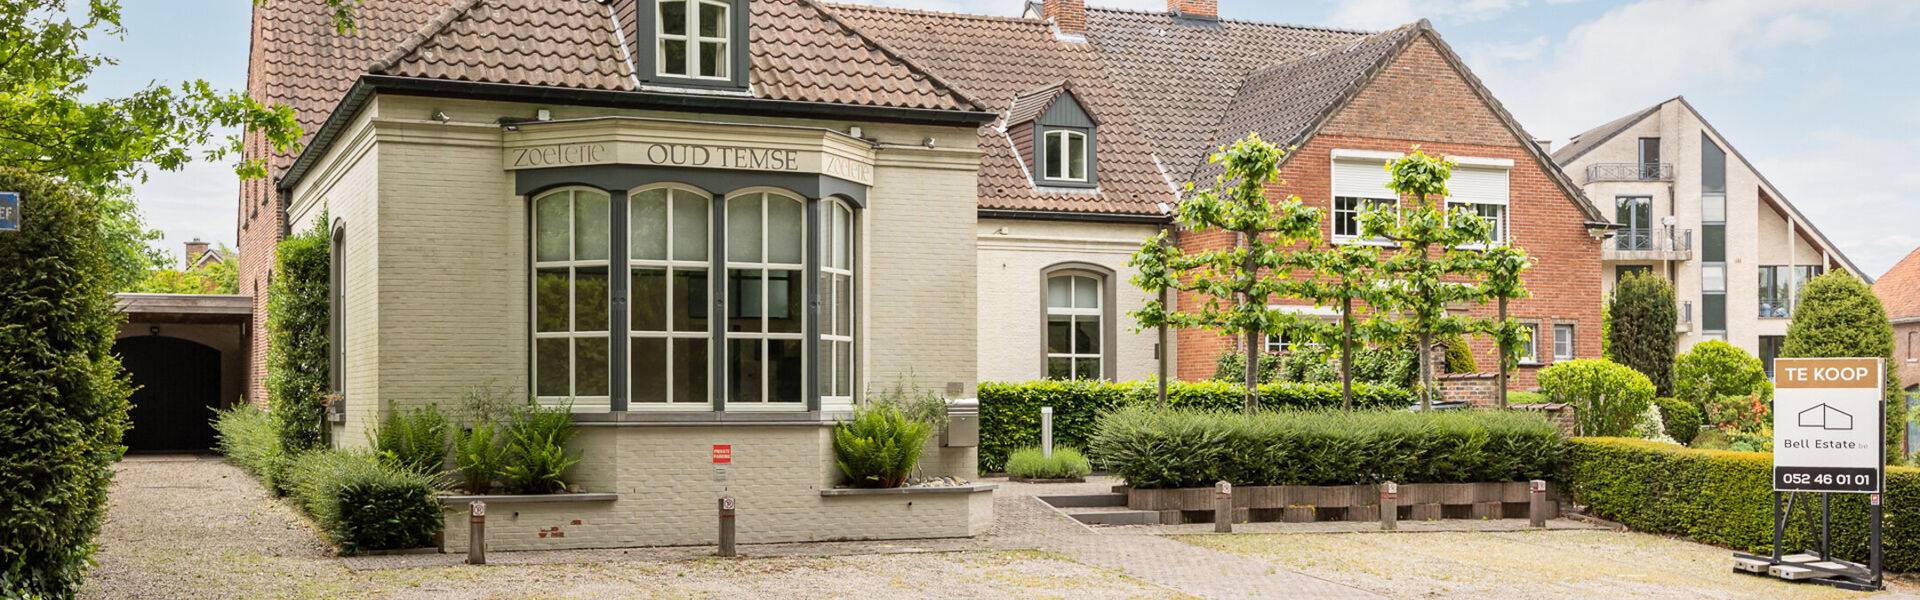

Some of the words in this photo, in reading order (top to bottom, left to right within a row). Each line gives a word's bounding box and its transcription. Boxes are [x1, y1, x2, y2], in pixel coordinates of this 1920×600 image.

[647, 143, 710, 166] OUD
[717, 147, 799, 171] TEMSE
[1784, 367, 1808, 381] TE
[1814, 367, 1869, 381] KOOP
[1784, 439, 1810, 449] Bell
[1815, 439, 1856, 449] Estate
[1783, 473, 1811, 484] 052
[1814, 474, 1833, 485] 46
[1836, 474, 1851, 485] 01
[1854, 474, 1870, 486] 01
